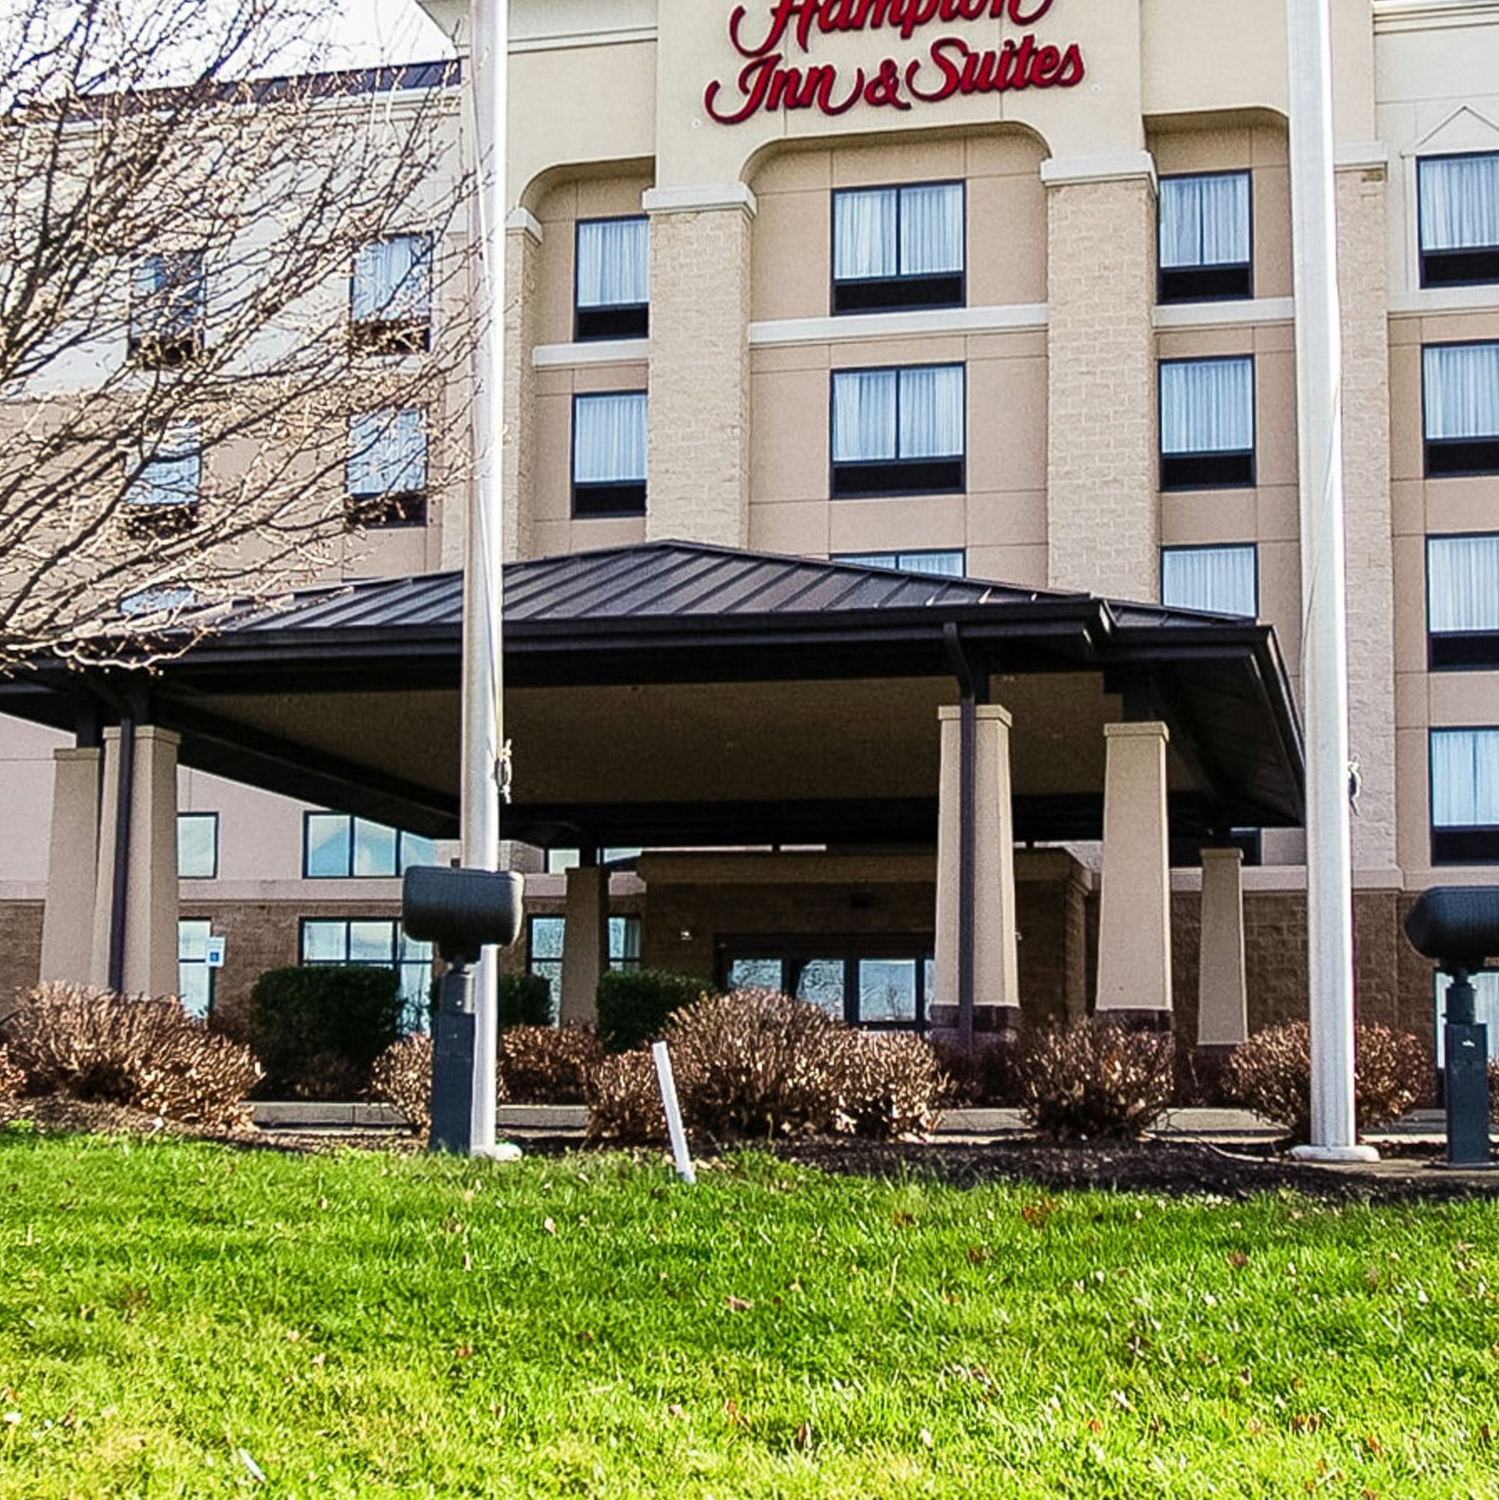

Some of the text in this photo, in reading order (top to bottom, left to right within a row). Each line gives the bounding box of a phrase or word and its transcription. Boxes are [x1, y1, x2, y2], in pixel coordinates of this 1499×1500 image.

[704, 33, 1085, 125] Inn & Suites
